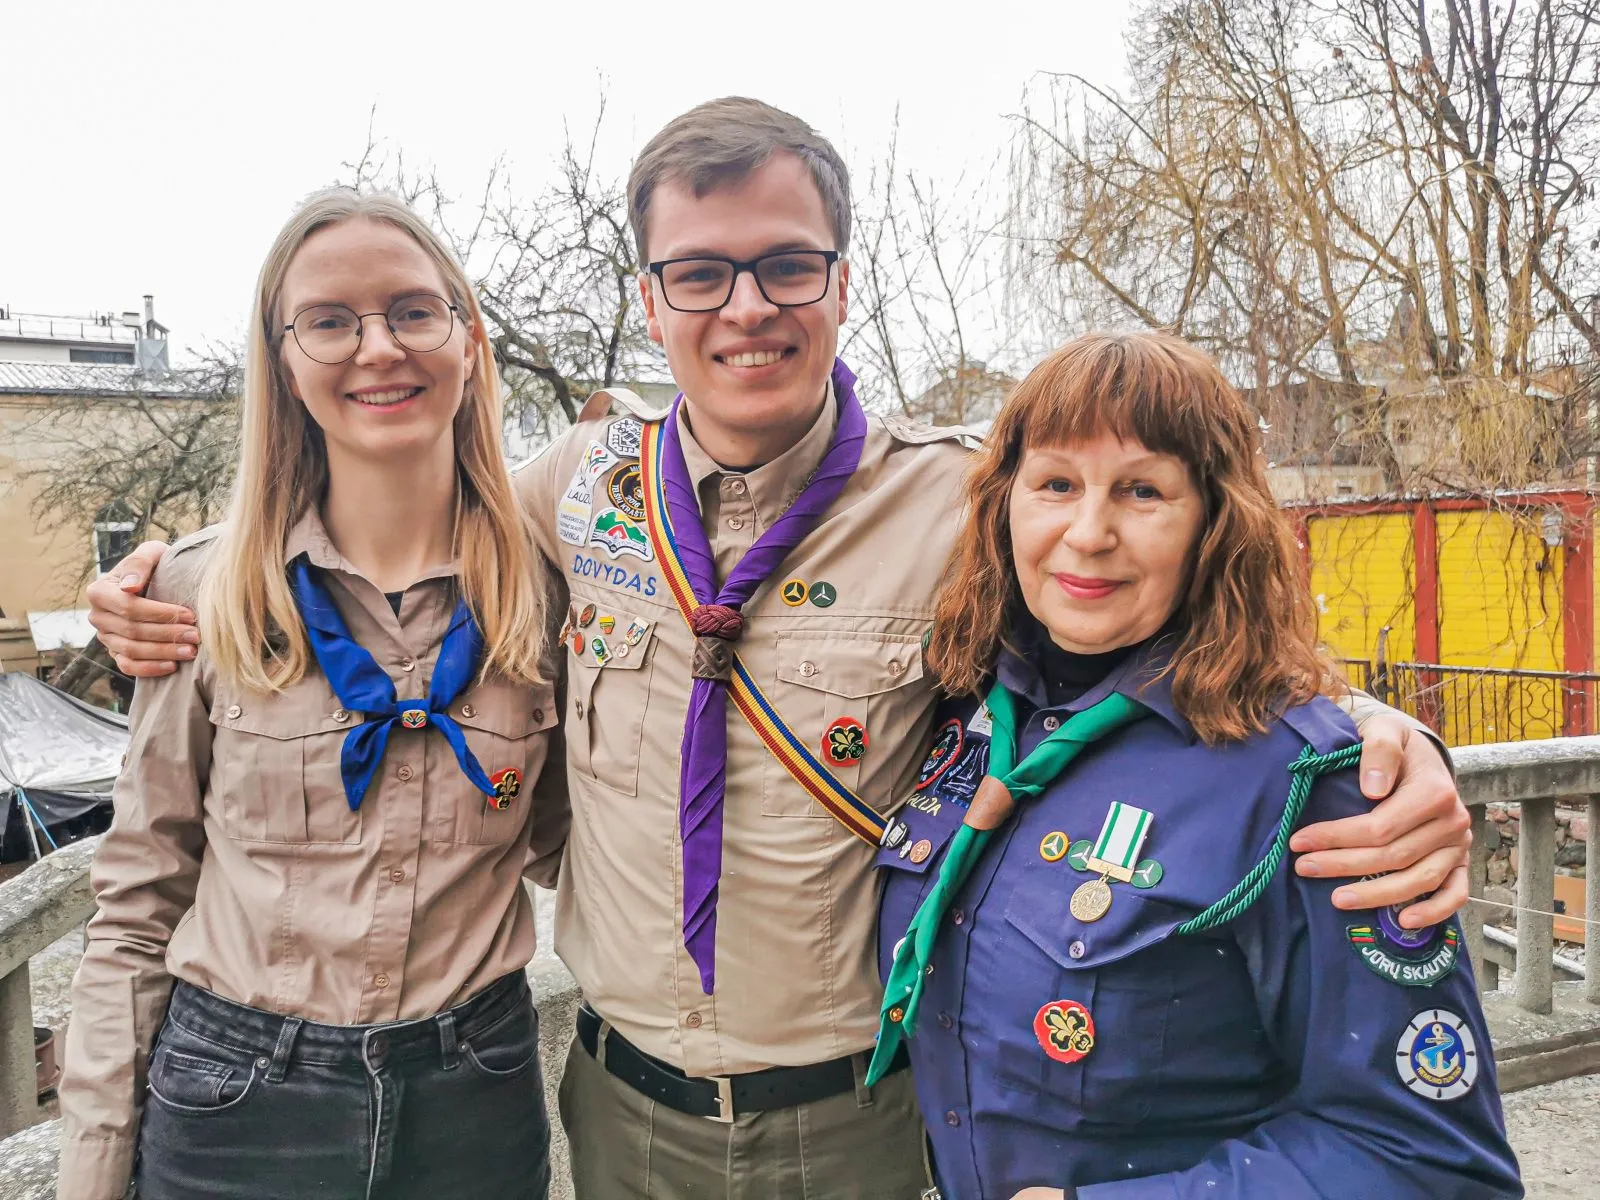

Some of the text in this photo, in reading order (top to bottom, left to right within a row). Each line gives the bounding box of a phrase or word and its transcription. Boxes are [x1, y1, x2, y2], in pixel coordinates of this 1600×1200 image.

[624, 495, 641, 508] 2016
[573, 554, 657, 596] DOVYDAS
[1402, 945, 1453, 980] SKAUTAI
